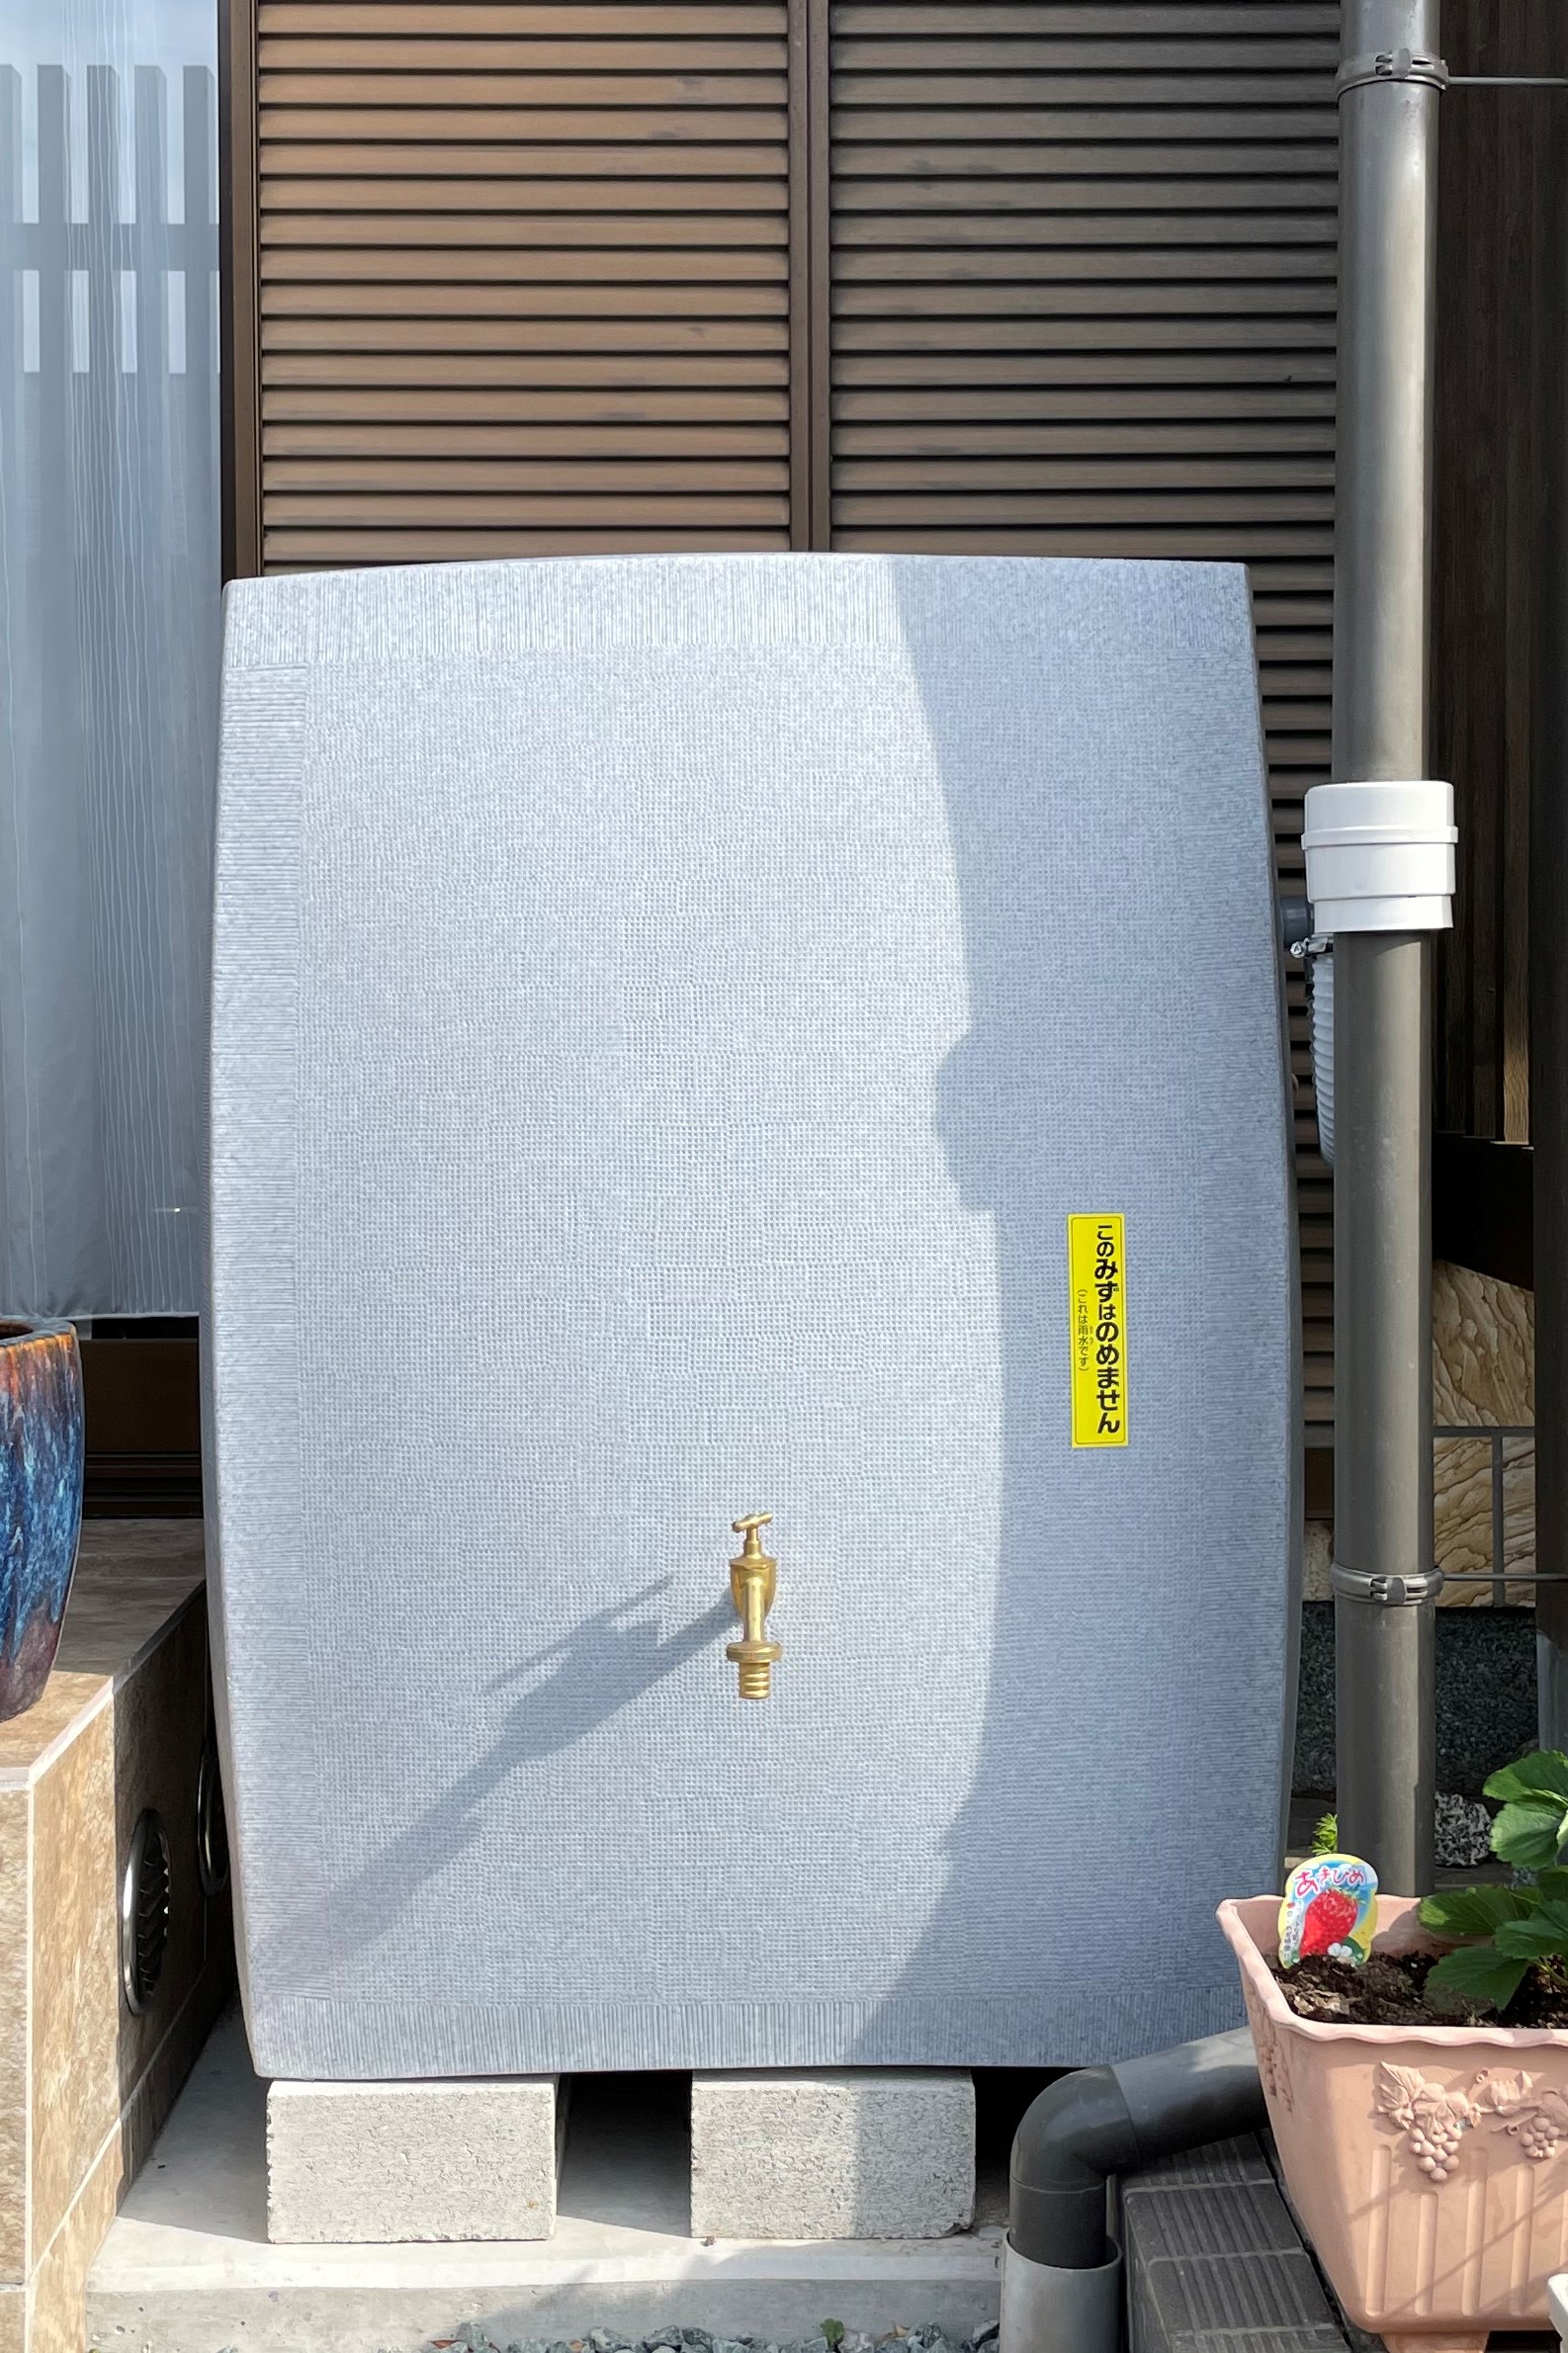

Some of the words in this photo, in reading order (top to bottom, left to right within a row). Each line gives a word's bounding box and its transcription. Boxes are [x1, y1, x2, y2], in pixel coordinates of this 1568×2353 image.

[1094, 1224, 1120, 1434] このみずはのめません
